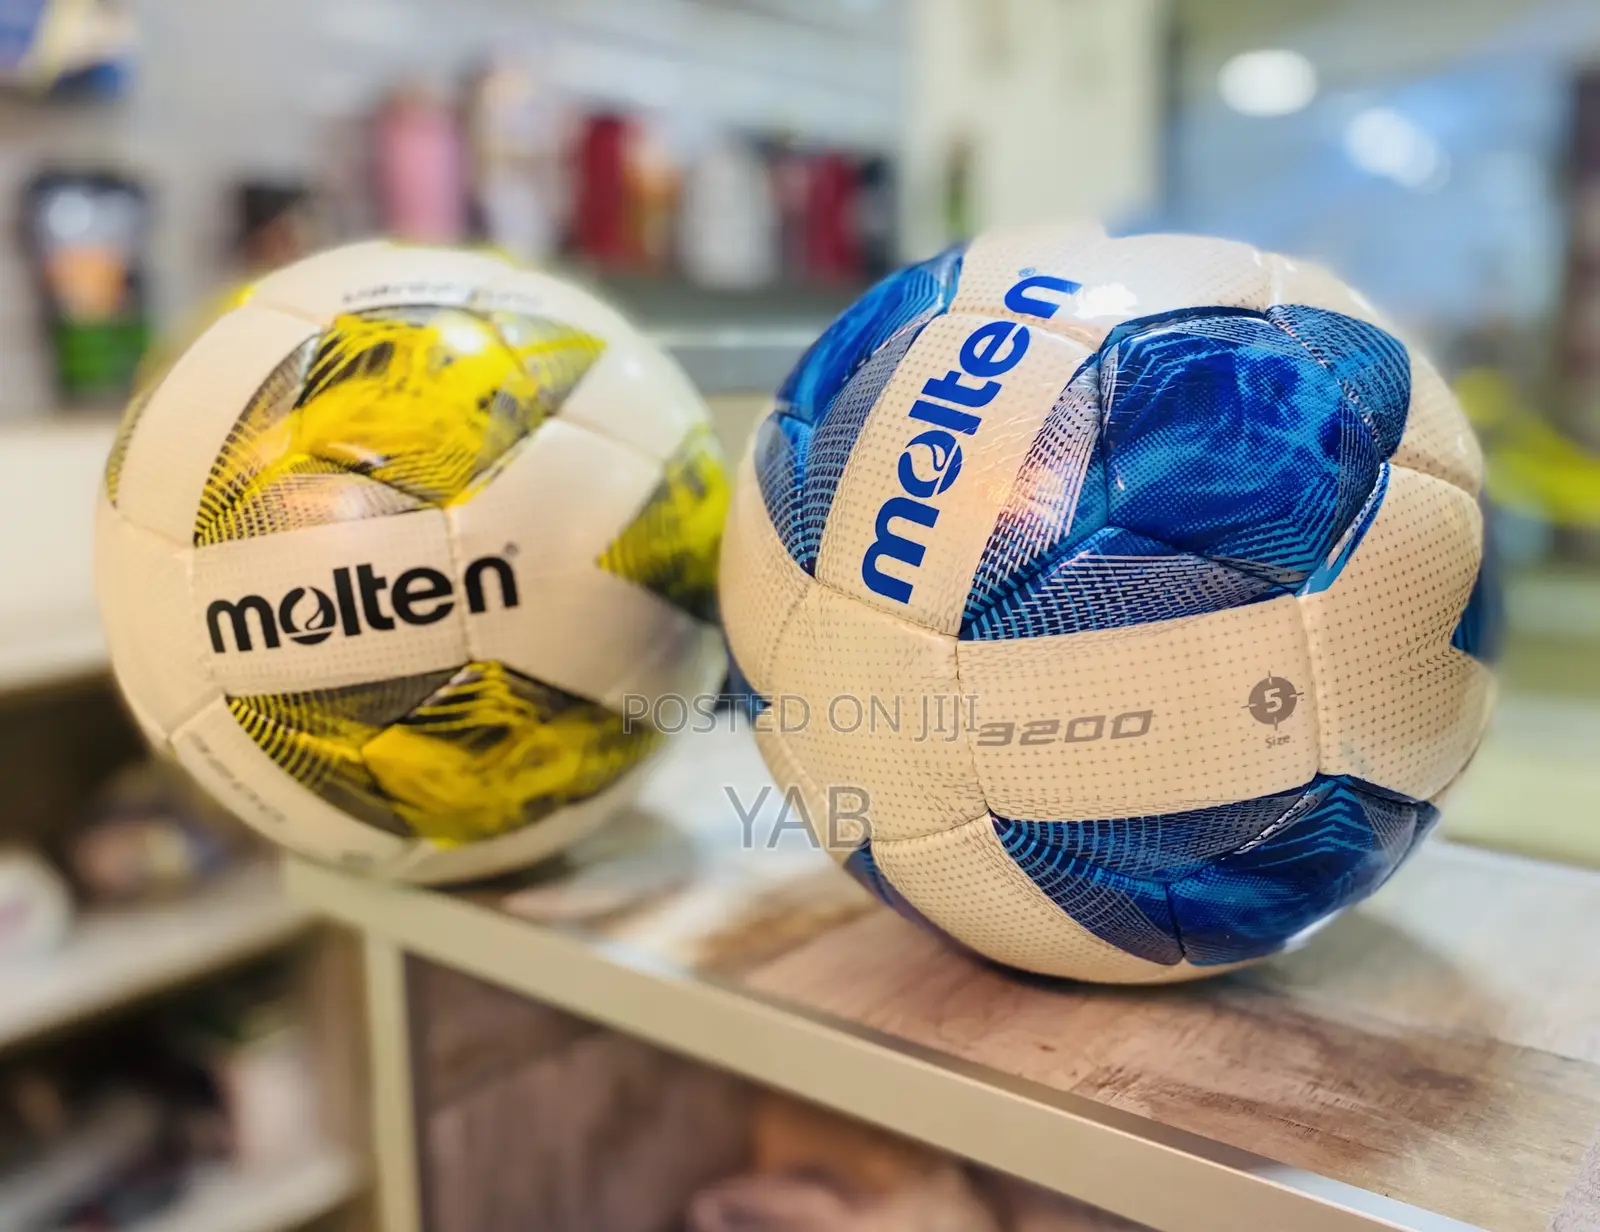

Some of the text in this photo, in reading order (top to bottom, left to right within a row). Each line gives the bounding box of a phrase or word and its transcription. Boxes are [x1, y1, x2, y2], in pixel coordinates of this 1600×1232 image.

[861, 274, 1083, 605] molten
[206, 556, 520, 654] molten
[976, 709, 1154, 747] 3200
[1263, 687, 1283, 714] 5
